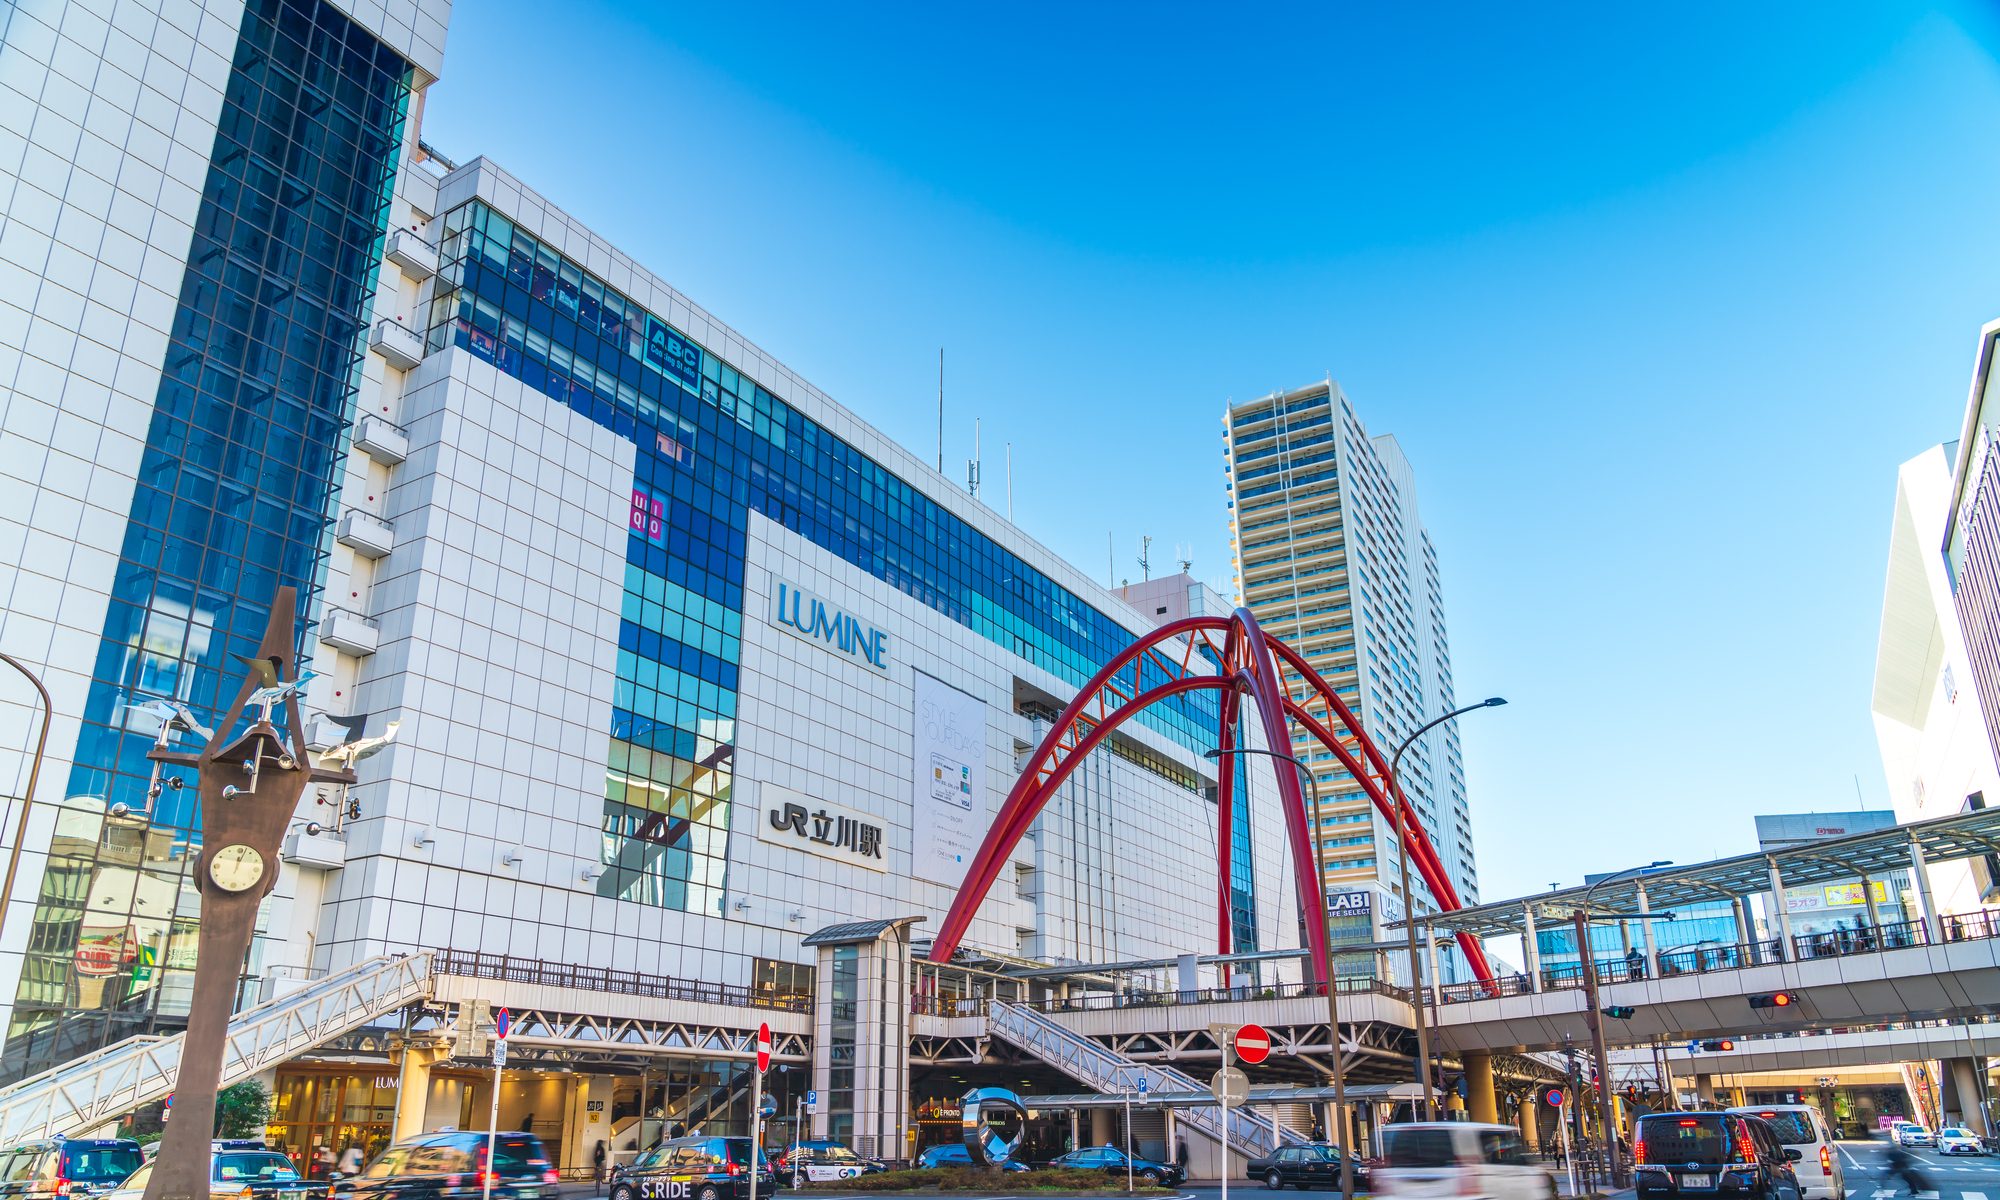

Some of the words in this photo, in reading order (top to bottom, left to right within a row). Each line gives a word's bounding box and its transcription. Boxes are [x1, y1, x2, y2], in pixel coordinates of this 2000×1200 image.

[652, 329, 697, 367] ABC
[777, 583, 888, 670] LUMINE
[922, 699, 958, 727] STYLE
[769, 801, 882, 860] JR立川駅
[1327, 892, 1370, 911] LABI
[1343, 908, 1370, 917] SELECT
[1140, 1079, 1146, 1091] P
[809, 1092, 816, 1103] P
[944, 1109, 960, 1117] PRONTO
[641, 1181, 692, 1199] S.RIDE
